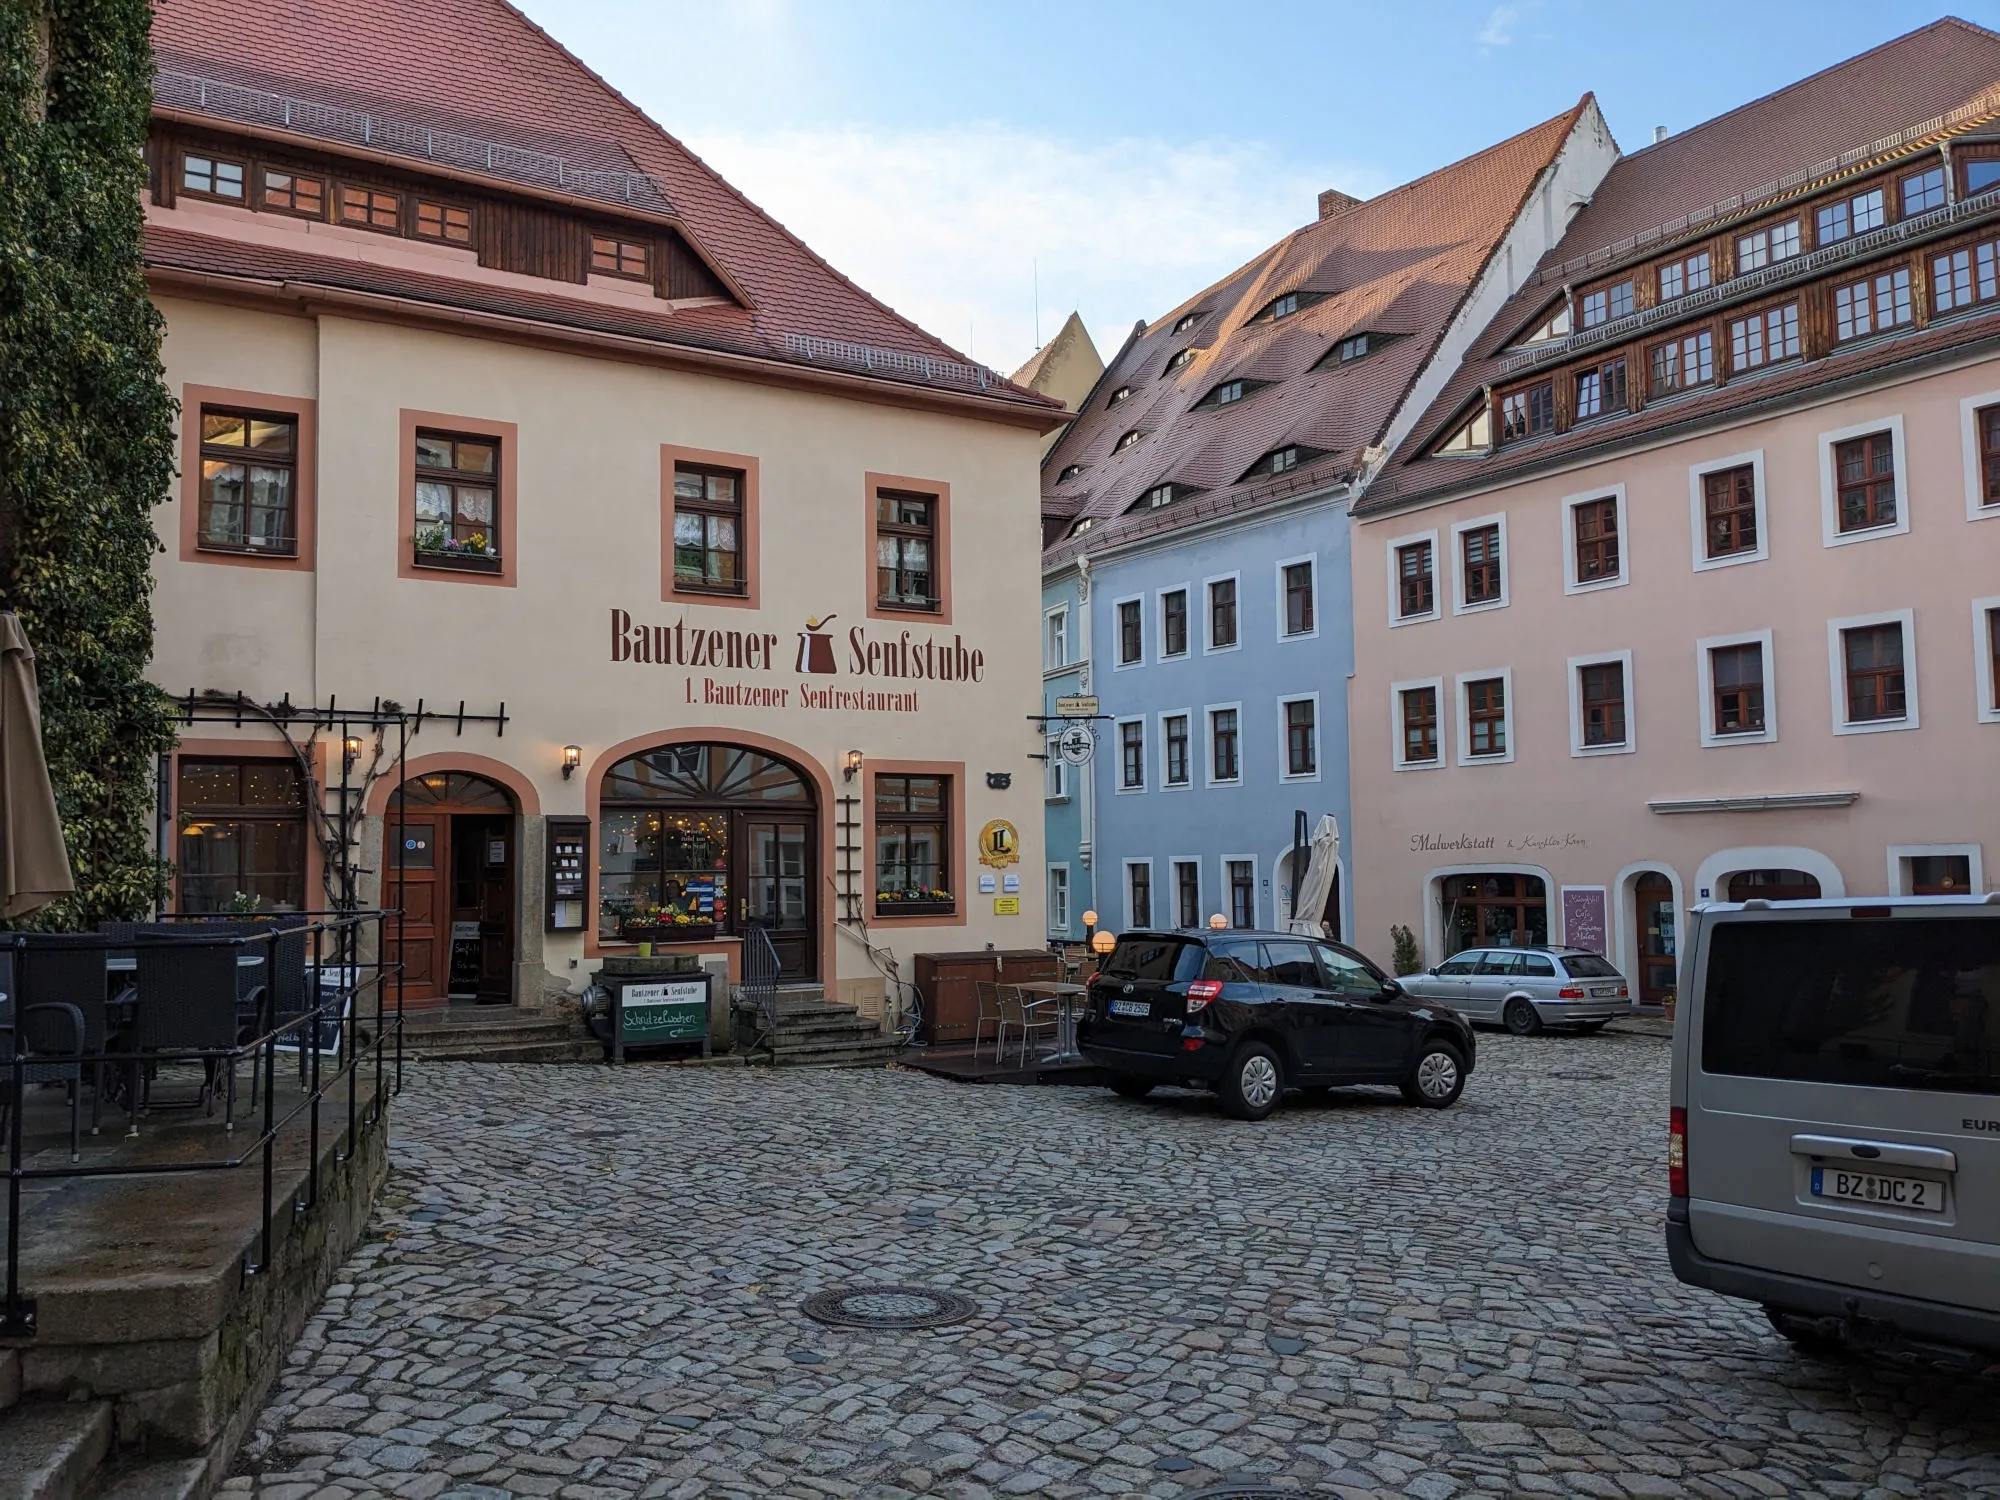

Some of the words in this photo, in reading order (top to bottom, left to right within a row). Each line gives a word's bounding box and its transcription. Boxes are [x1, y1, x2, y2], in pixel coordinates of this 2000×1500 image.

[610, 608, 778, 670] Bautzener
[849, 626, 984, 683] Senfstube
[685, 677, 698, 704] 1.
[703, 678, 789, 708] Bautzener
[800, 682, 920, 712] Senfrestaurant
[1410, 833, 1495, 851] Malwerkstatt
[631, 988, 660, 998] Bautzener
[671, 986, 698, 996] Senfstube
[623, 1009, 697, 1026] Schnitzelwochen
[1837, 1173, 1863, 1198] BZ
[1878, 1178, 1906, 1202] DC
[1911, 1183, 1925, 1206] 2
